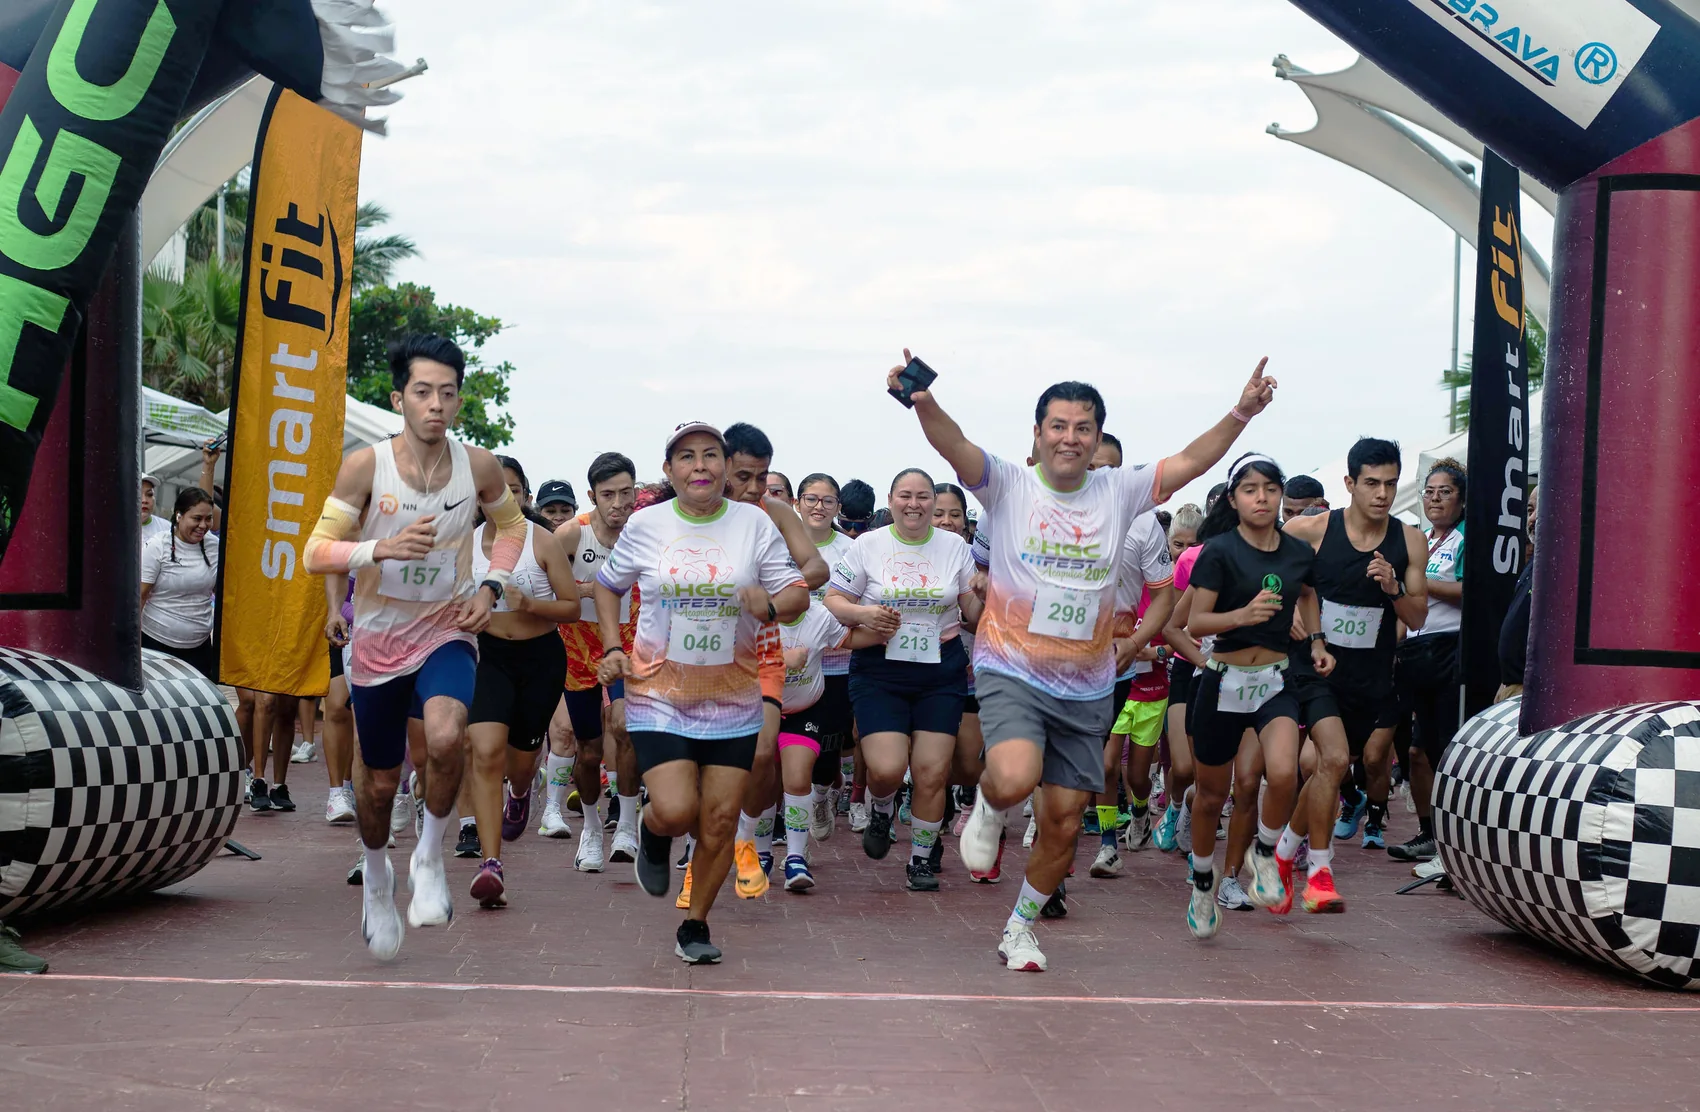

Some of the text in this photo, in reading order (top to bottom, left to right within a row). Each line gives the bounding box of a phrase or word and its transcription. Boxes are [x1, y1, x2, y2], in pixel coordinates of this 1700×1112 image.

[260, 202, 326, 581] smart fit
[1491, 204, 1523, 575] smart fit
[402, 503, 417, 511] NN
[1041, 540, 1101, 558] HGC
[399, 565, 441, 586] 157
[516, 574, 525, 586] 5
[675, 583, 736, 597] HGC
[894, 588, 945, 598] HGC
[1047, 602, 1086, 625] 298
[925, 627, 935, 637] 5
[1332, 617, 1367, 636] 203
[683, 634, 721, 652] 046
[899, 635, 928, 651] 213
[1236, 683, 1269, 701] 170
